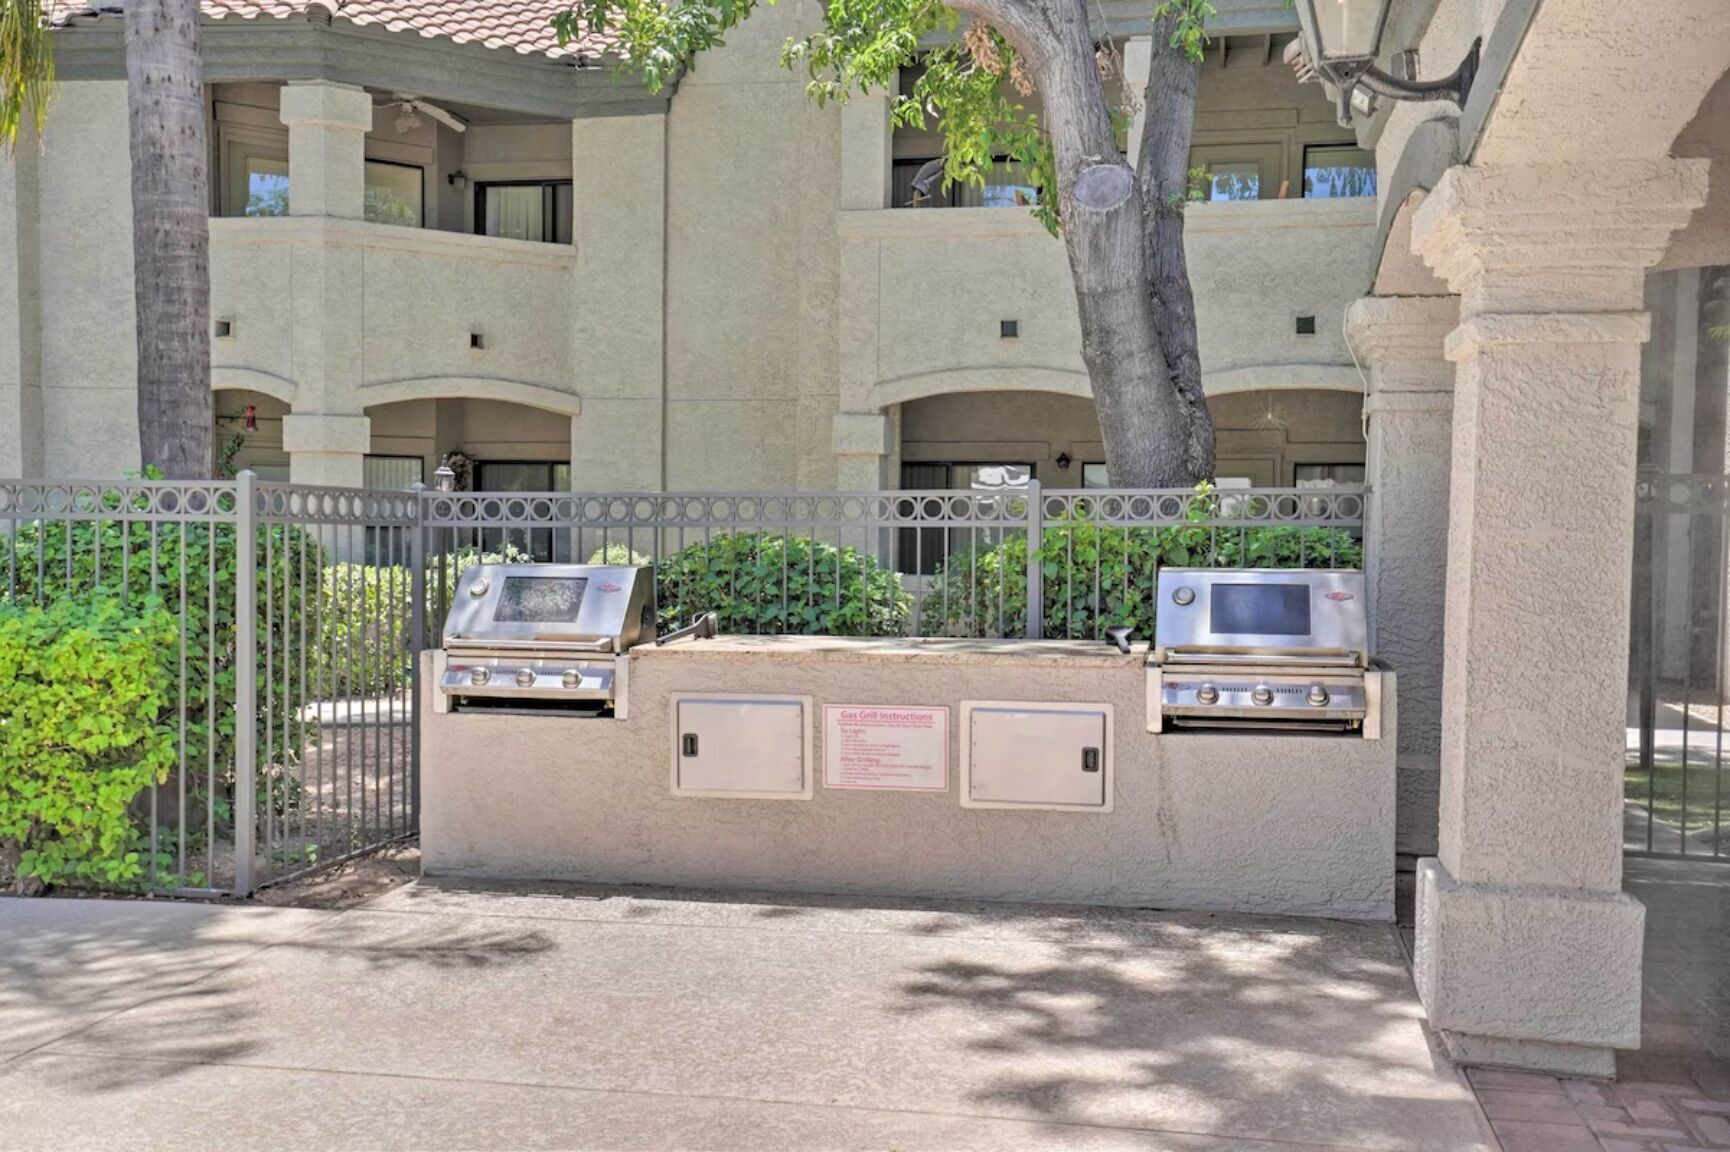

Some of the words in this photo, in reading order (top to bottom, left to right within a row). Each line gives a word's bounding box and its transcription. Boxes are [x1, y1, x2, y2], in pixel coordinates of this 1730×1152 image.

[841, 711, 857, 719] Gas
[859, 711, 878, 720] Grill
[880, 712, 933, 721] Instructions
